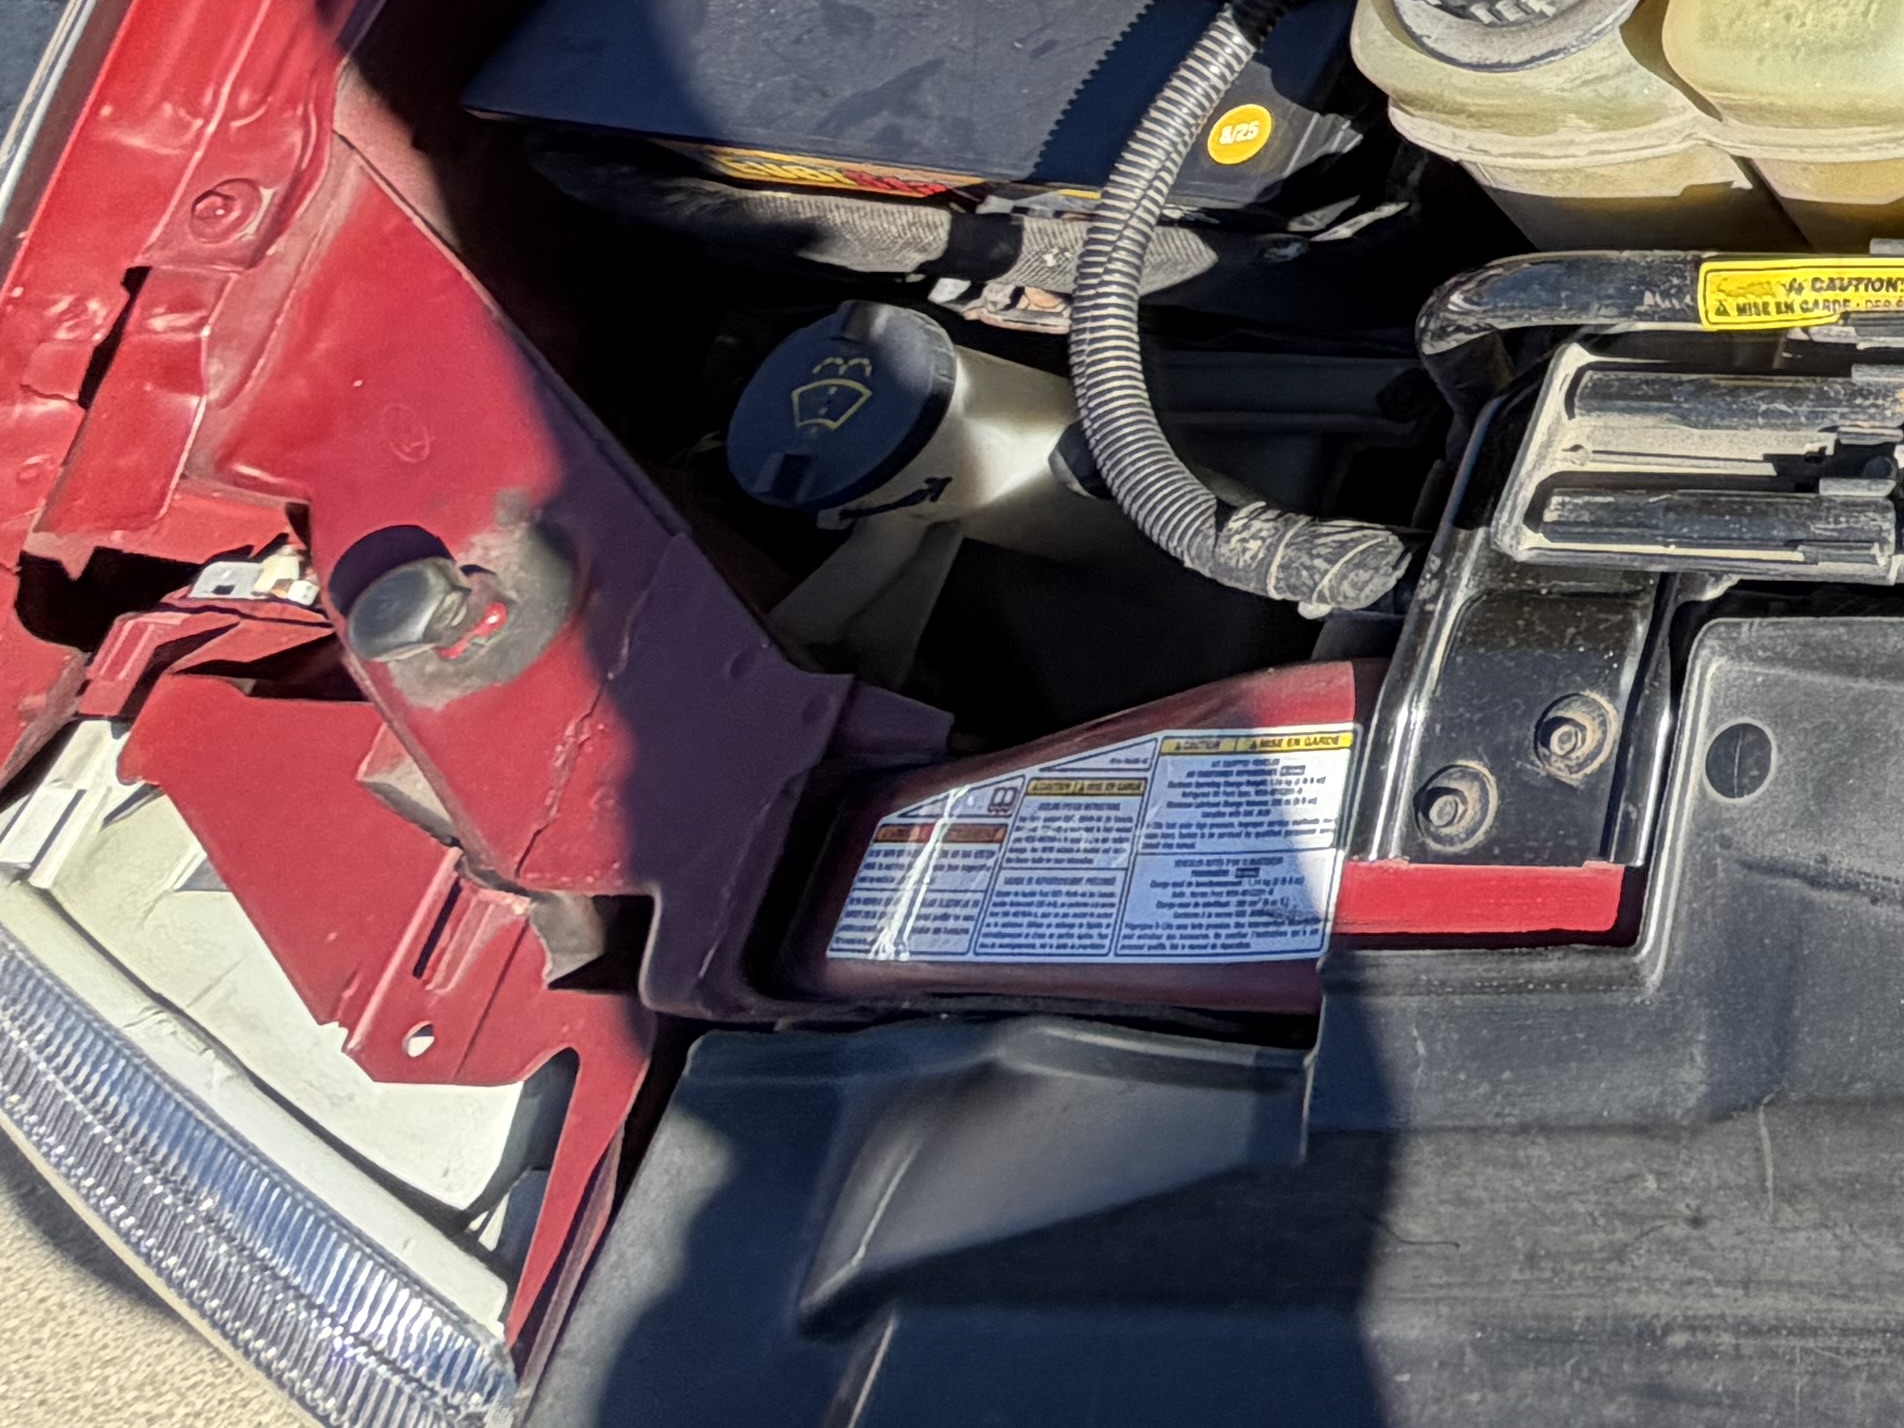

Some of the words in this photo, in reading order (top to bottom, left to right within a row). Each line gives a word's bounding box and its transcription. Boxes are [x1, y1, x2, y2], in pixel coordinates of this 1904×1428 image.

[1736, 299, 1771, 316] MISE
[1775, 297, 1796, 315] EN
[1799, 297, 1851, 314] GARDE
[1259, 738, 1285, 749] MISE
[1287, 737, 1301, 747] EN
[1304, 735, 1340, 746] GARDE
